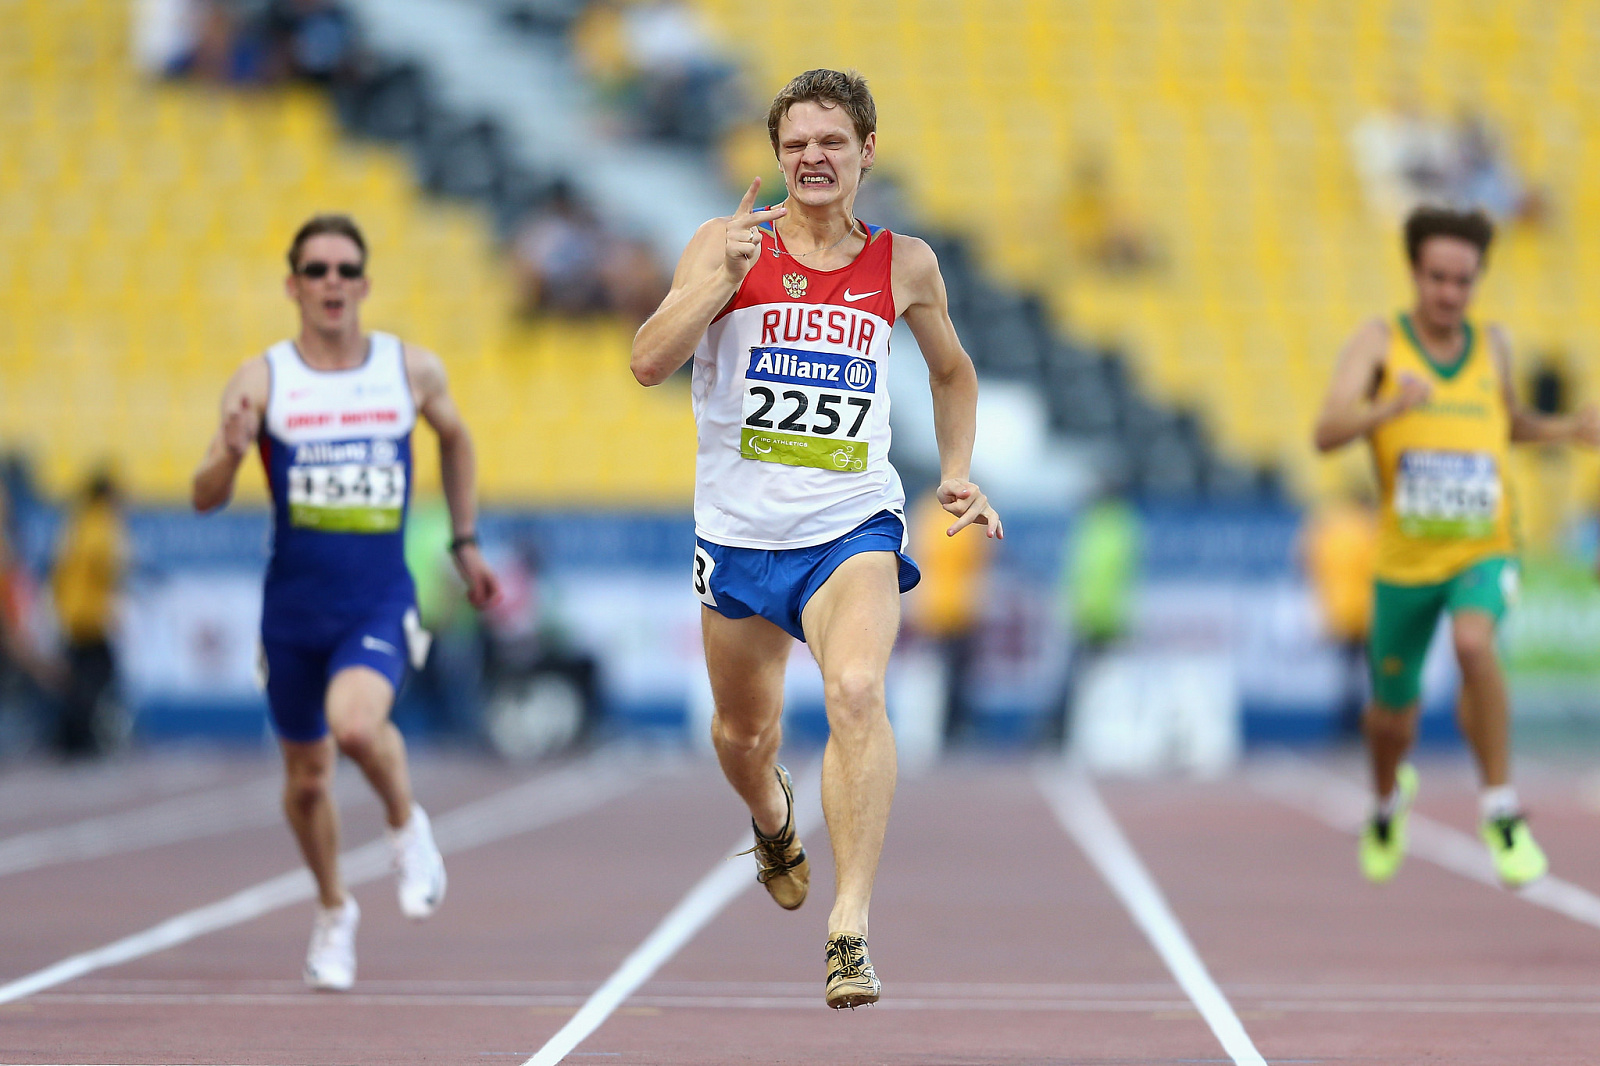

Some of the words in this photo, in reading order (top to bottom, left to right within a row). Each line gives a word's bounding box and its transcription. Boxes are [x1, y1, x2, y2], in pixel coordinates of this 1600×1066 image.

[761, 308, 875, 356] RUSSIA
[755, 352, 841, 382] Allianz
[745, 386, 872, 438] 2257
[773, 439, 808, 448] ATHLETICS
[695, 554, 706, 595] 3
